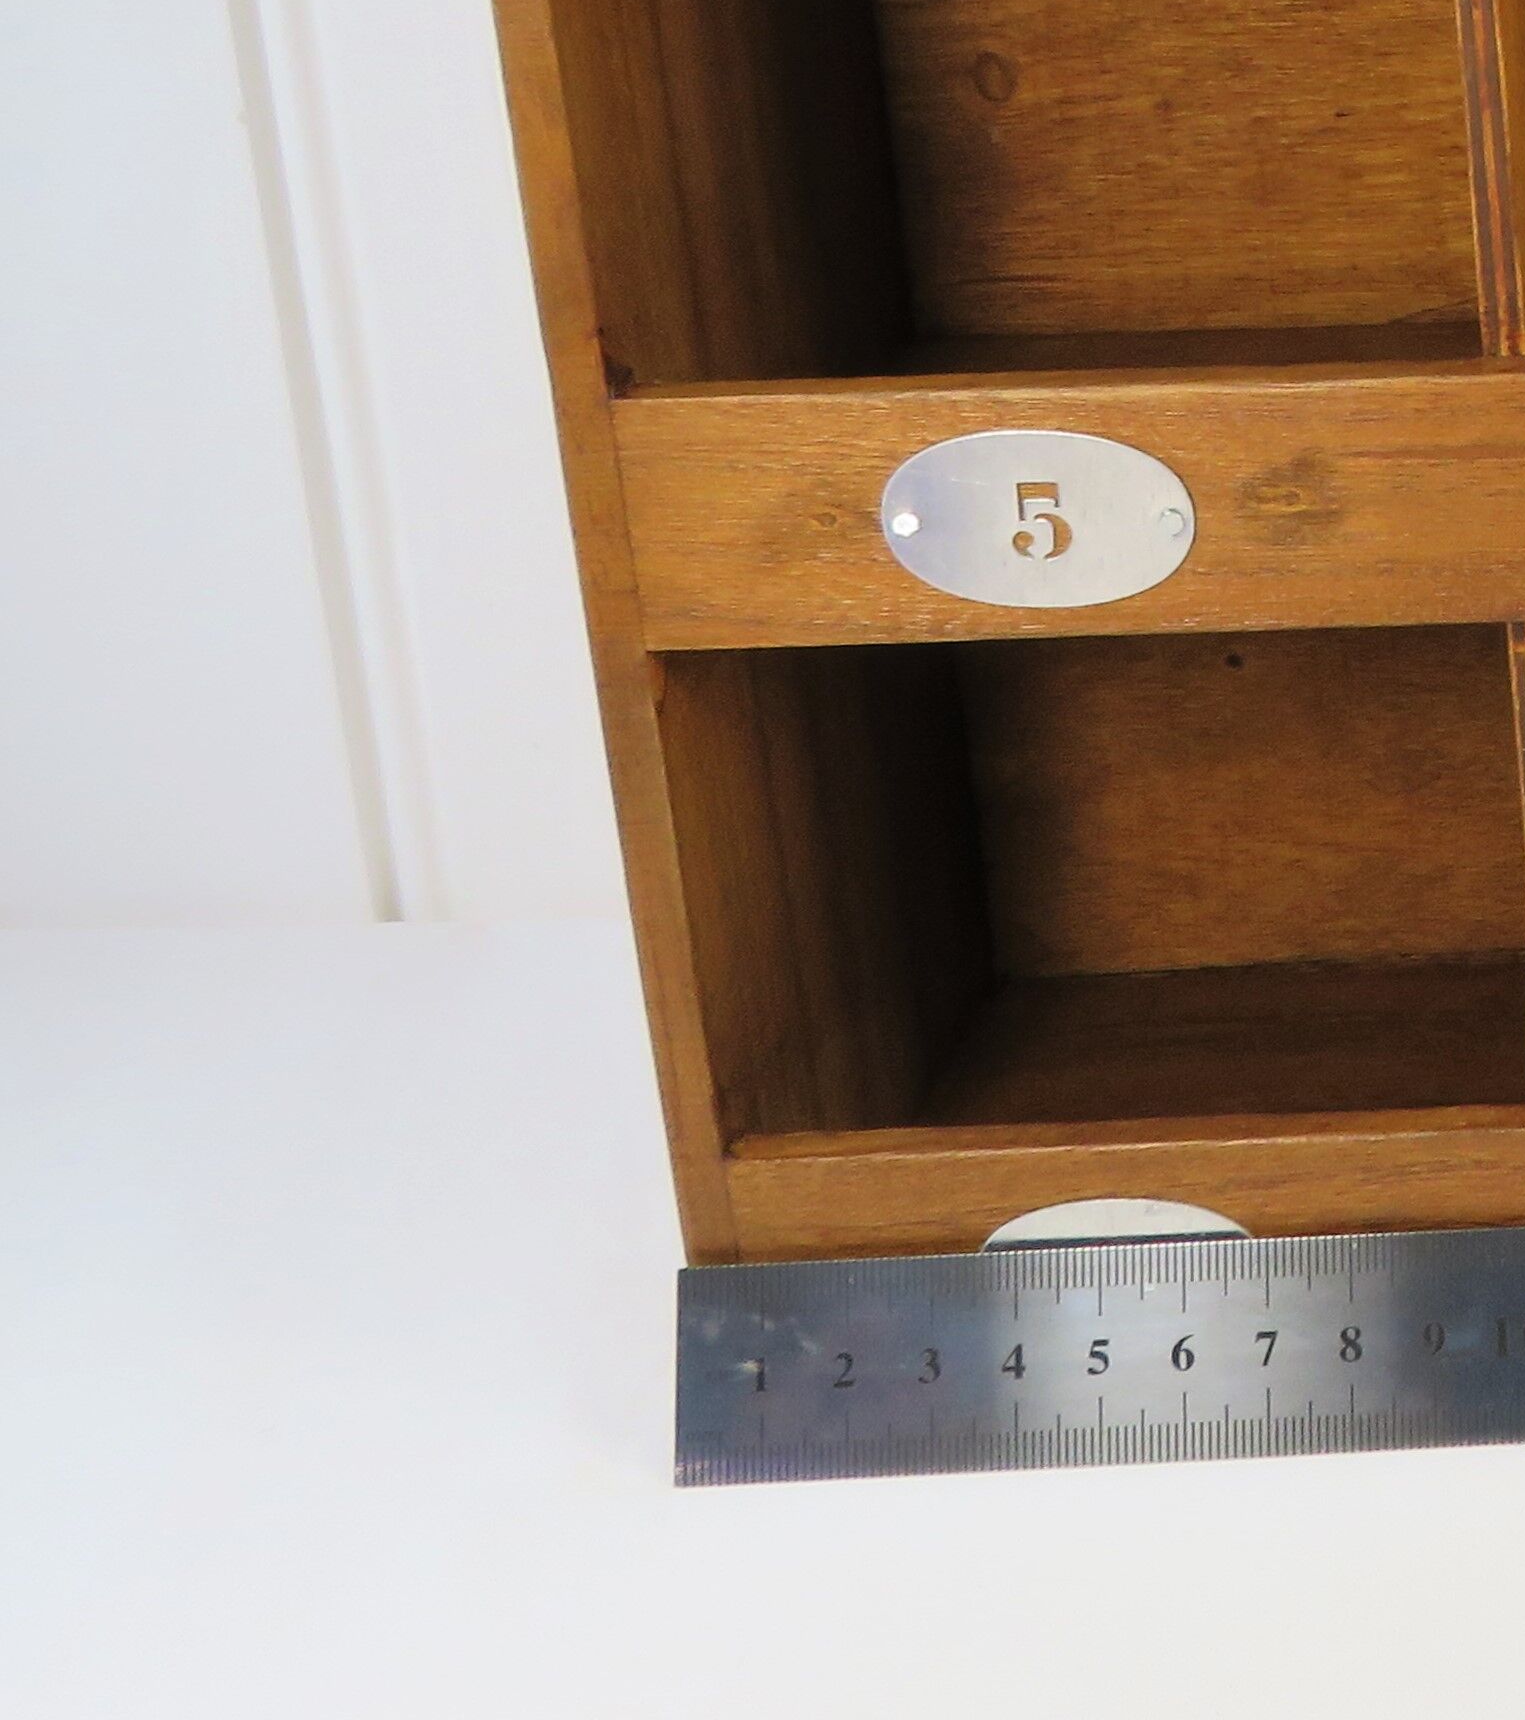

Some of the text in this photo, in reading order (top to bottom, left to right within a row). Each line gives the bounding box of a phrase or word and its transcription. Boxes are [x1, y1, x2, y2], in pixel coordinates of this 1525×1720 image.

[1012, 481, 1073, 561] 5
[832, 1352, 856, 1388] 2
[918, 1347, 942, 1384] 3
[1002, 1344, 1027, 1380] 4
[1087, 1338, 1111, 1375] 5
[1171, 1334, 1195, 1372] 6
[1255, 1330, 1279, 1367] 7
[1339, 1326, 1363, 1363] 8
[1424, 1321, 1446, 1357] 9
